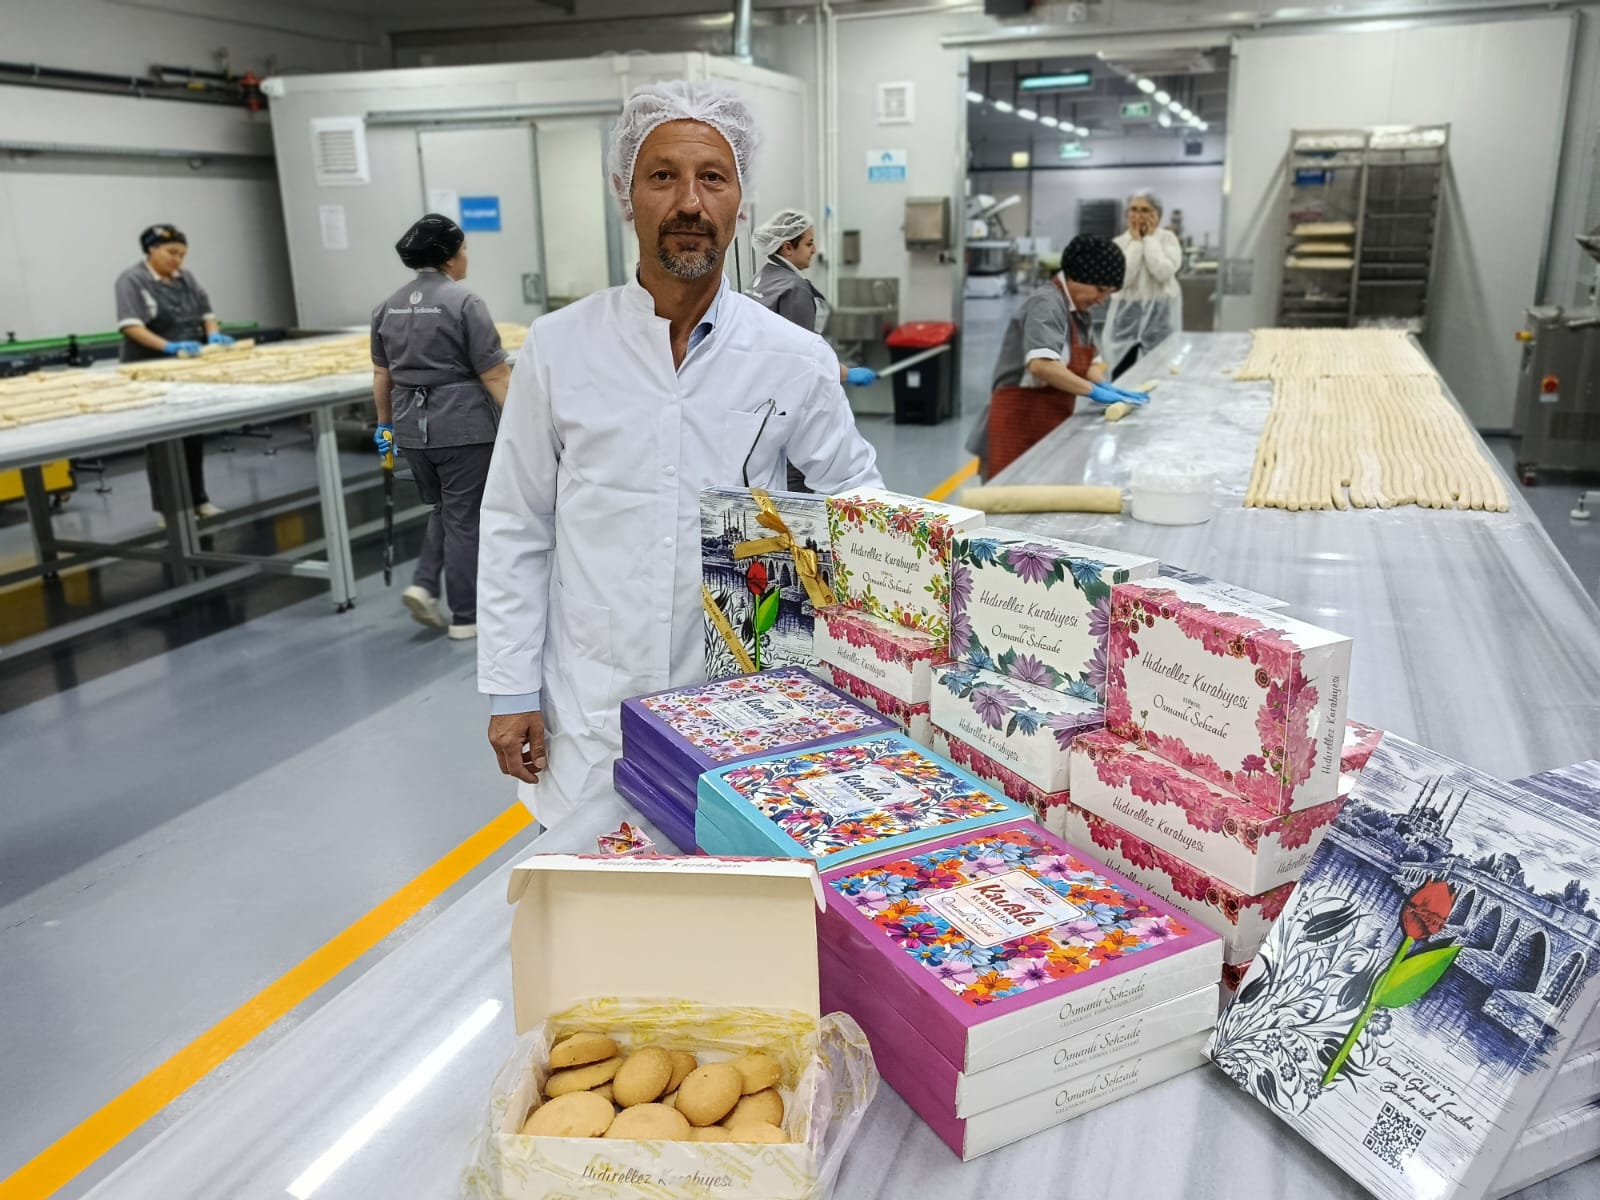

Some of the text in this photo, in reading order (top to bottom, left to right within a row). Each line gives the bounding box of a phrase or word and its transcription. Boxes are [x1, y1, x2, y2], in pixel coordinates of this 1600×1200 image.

[980, 589, 1080, 629] Hıdırellez Kurabiyesi
[991, 624, 1026, 646] Osmanlı
[1142, 650, 1251, 710] Hıdırellez Kurabiyesi
[1153, 694, 1193, 722] Osmanlı
[1112, 796, 1155, 828] Hıdırellez
[1058, 988, 1106, 1020] Osmanlı
[1053, 1034, 1101, 1066] Osmanlı
[1055, 1074, 1101, 1108] Osmanlı
